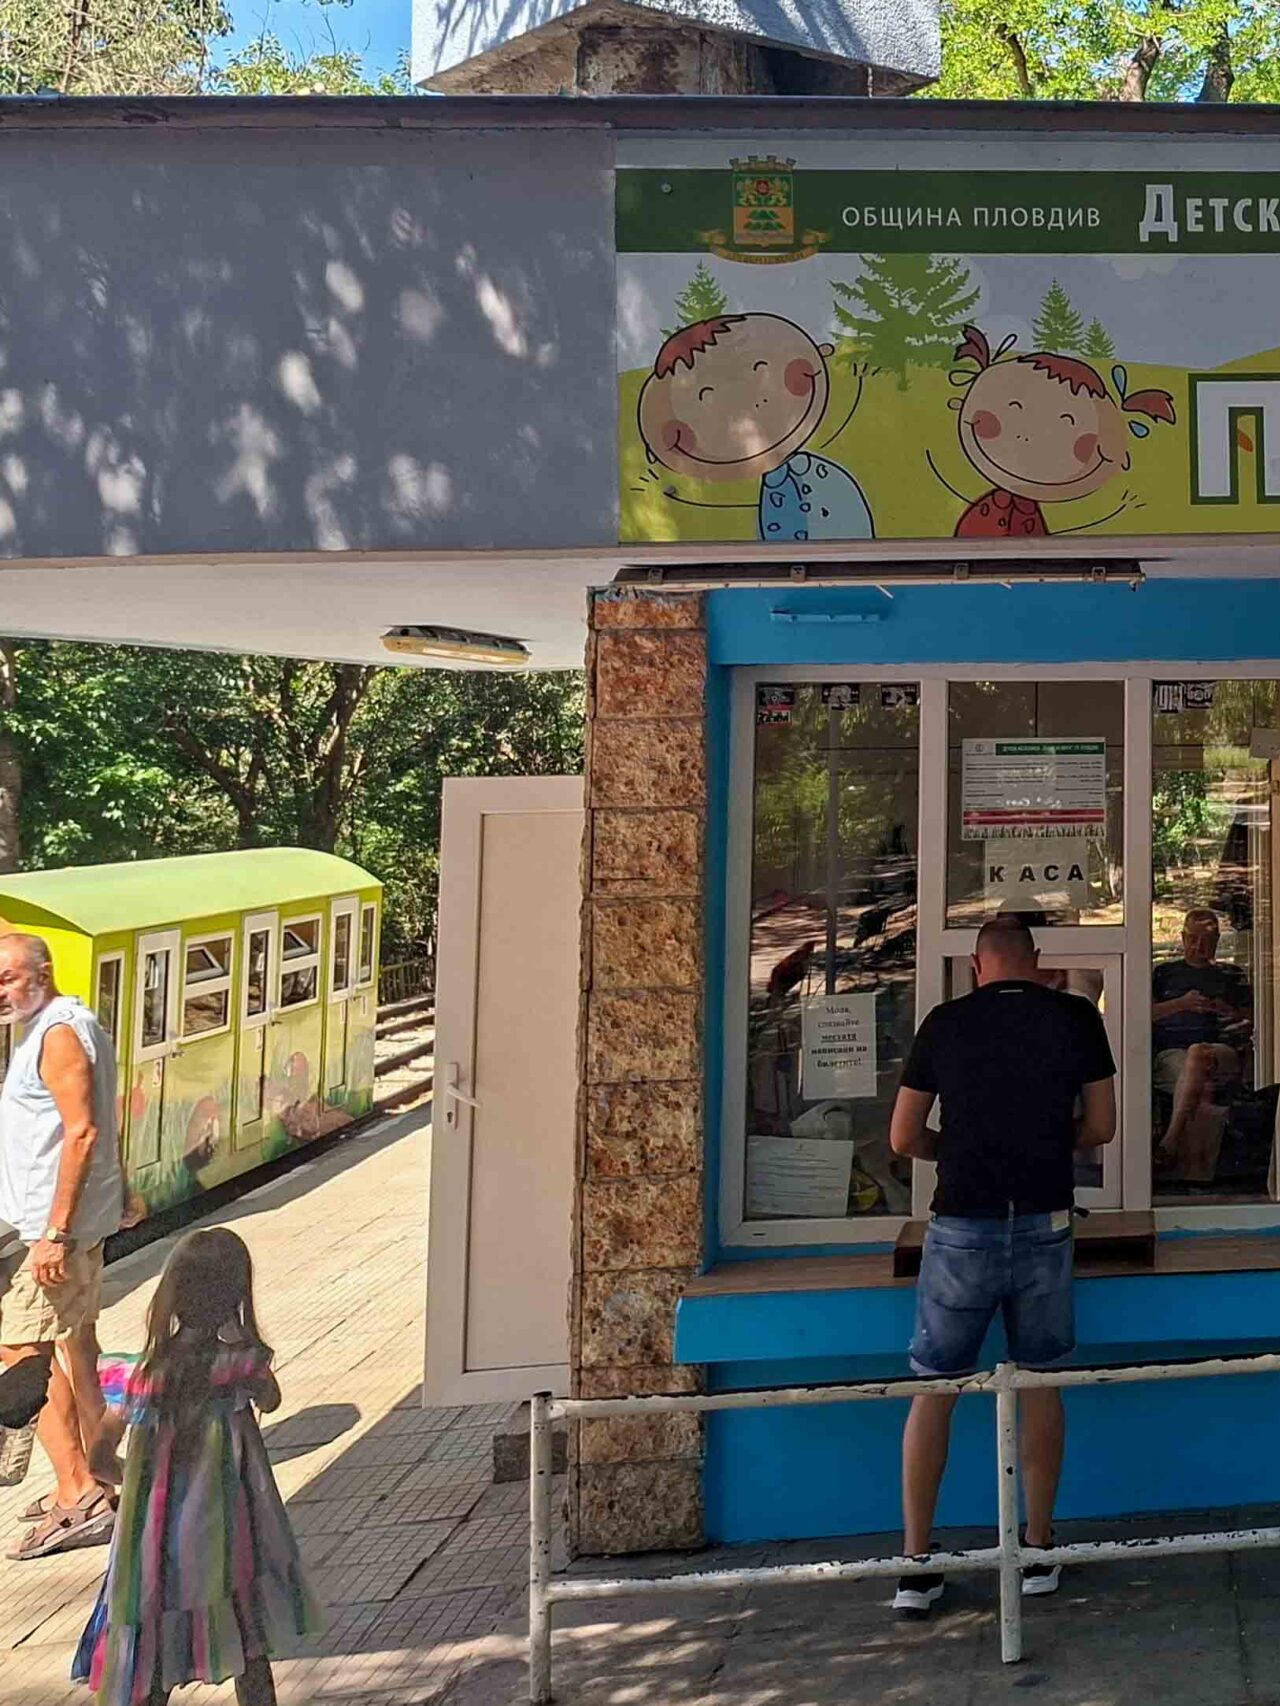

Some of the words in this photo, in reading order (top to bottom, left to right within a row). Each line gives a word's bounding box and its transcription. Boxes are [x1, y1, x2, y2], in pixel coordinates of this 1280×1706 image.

[842, 207, 962, 229] ОБЩИНА
[973, 207, 1101, 230] ПЛОВДИВ
[989, 864, 1084, 882] КАСА
